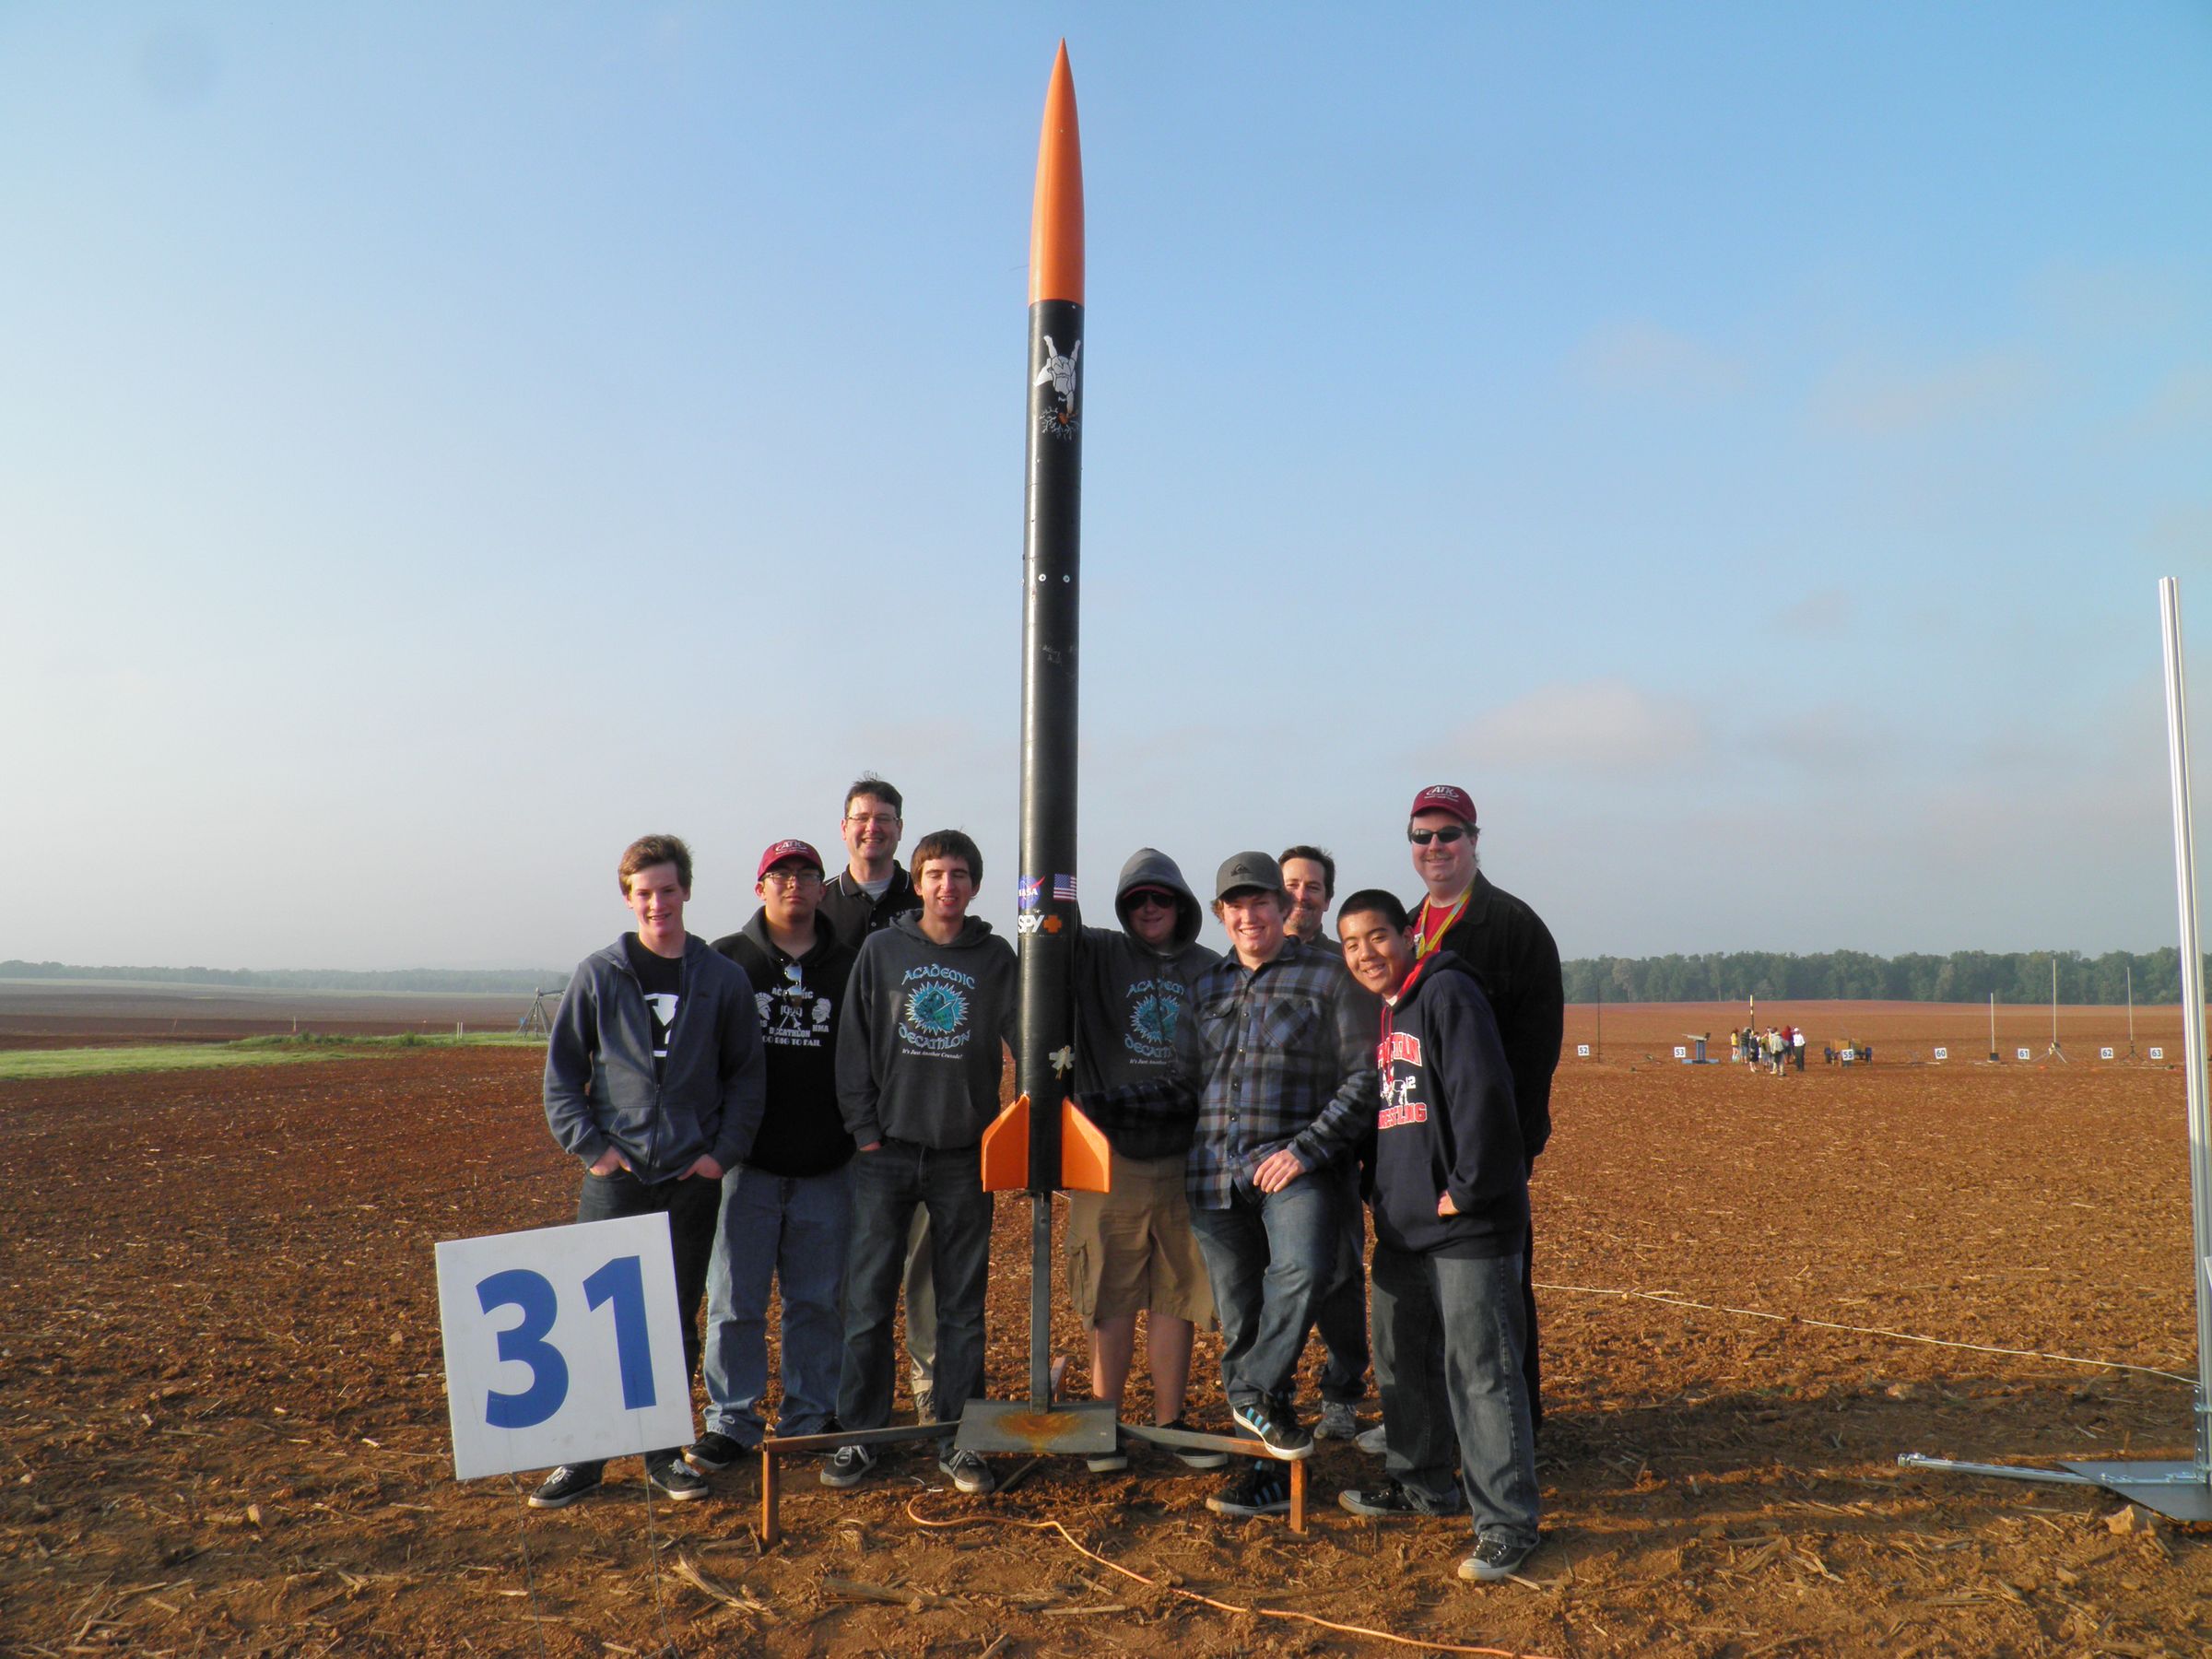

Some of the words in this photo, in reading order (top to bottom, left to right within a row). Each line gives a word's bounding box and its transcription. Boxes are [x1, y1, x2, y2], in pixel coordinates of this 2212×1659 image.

[1018, 914, 1045, 934] SPY
[901, 963, 975, 990] ACADEMIC
[899, 1021, 971, 1051] DECATHLON
[476, 1255, 657, 1429] 31
